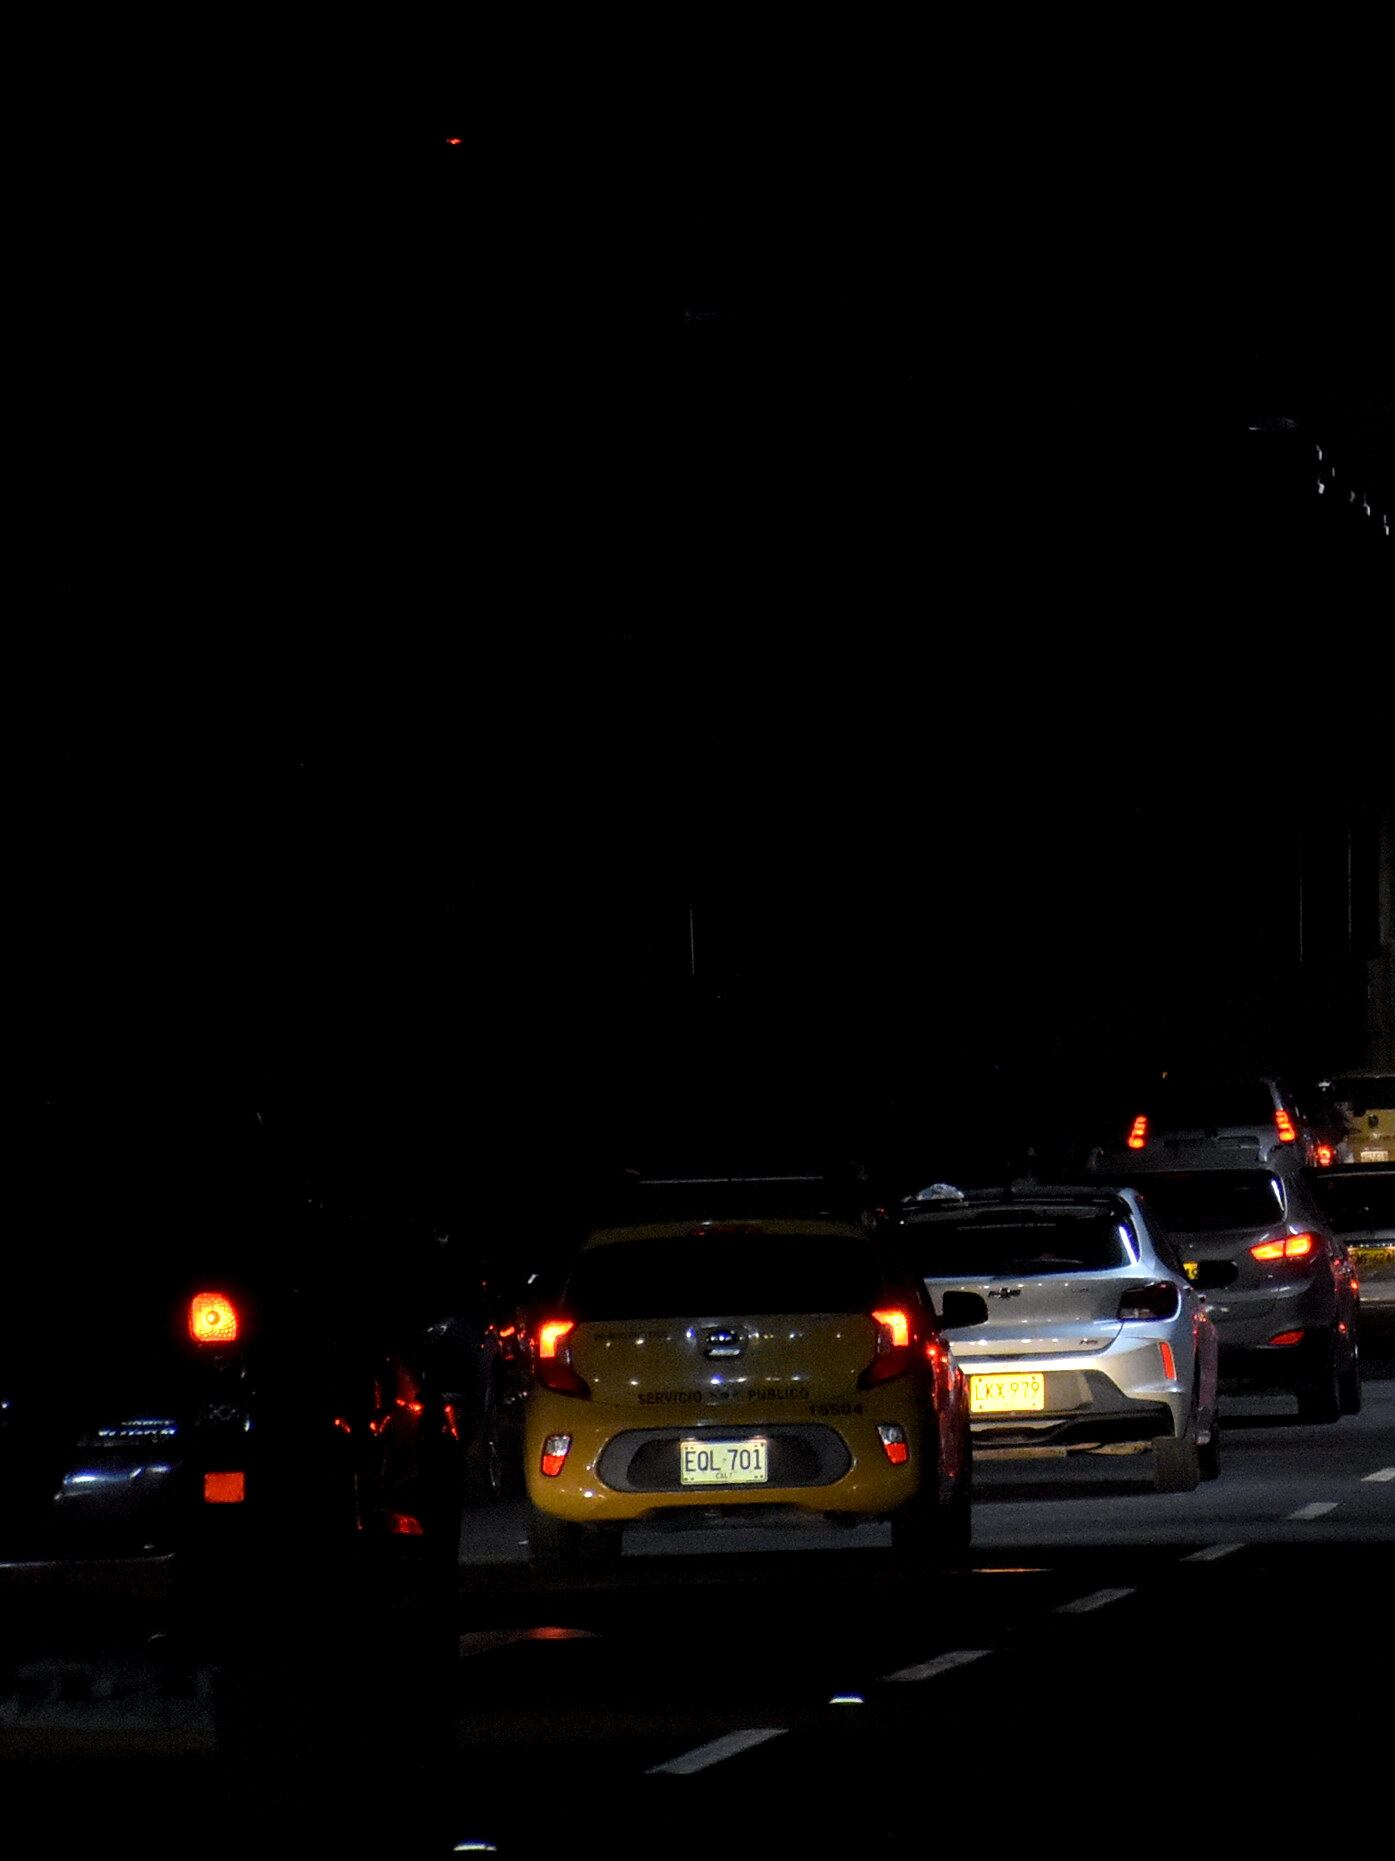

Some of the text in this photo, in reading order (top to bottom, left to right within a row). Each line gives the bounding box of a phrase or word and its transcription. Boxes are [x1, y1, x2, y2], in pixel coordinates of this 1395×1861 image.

[637, 1387, 810, 1405] SERVICIO PUBLICO
[975, 1381, 1040, 1401] LKX 979
[684, 1449, 762, 1472] EQL 701
